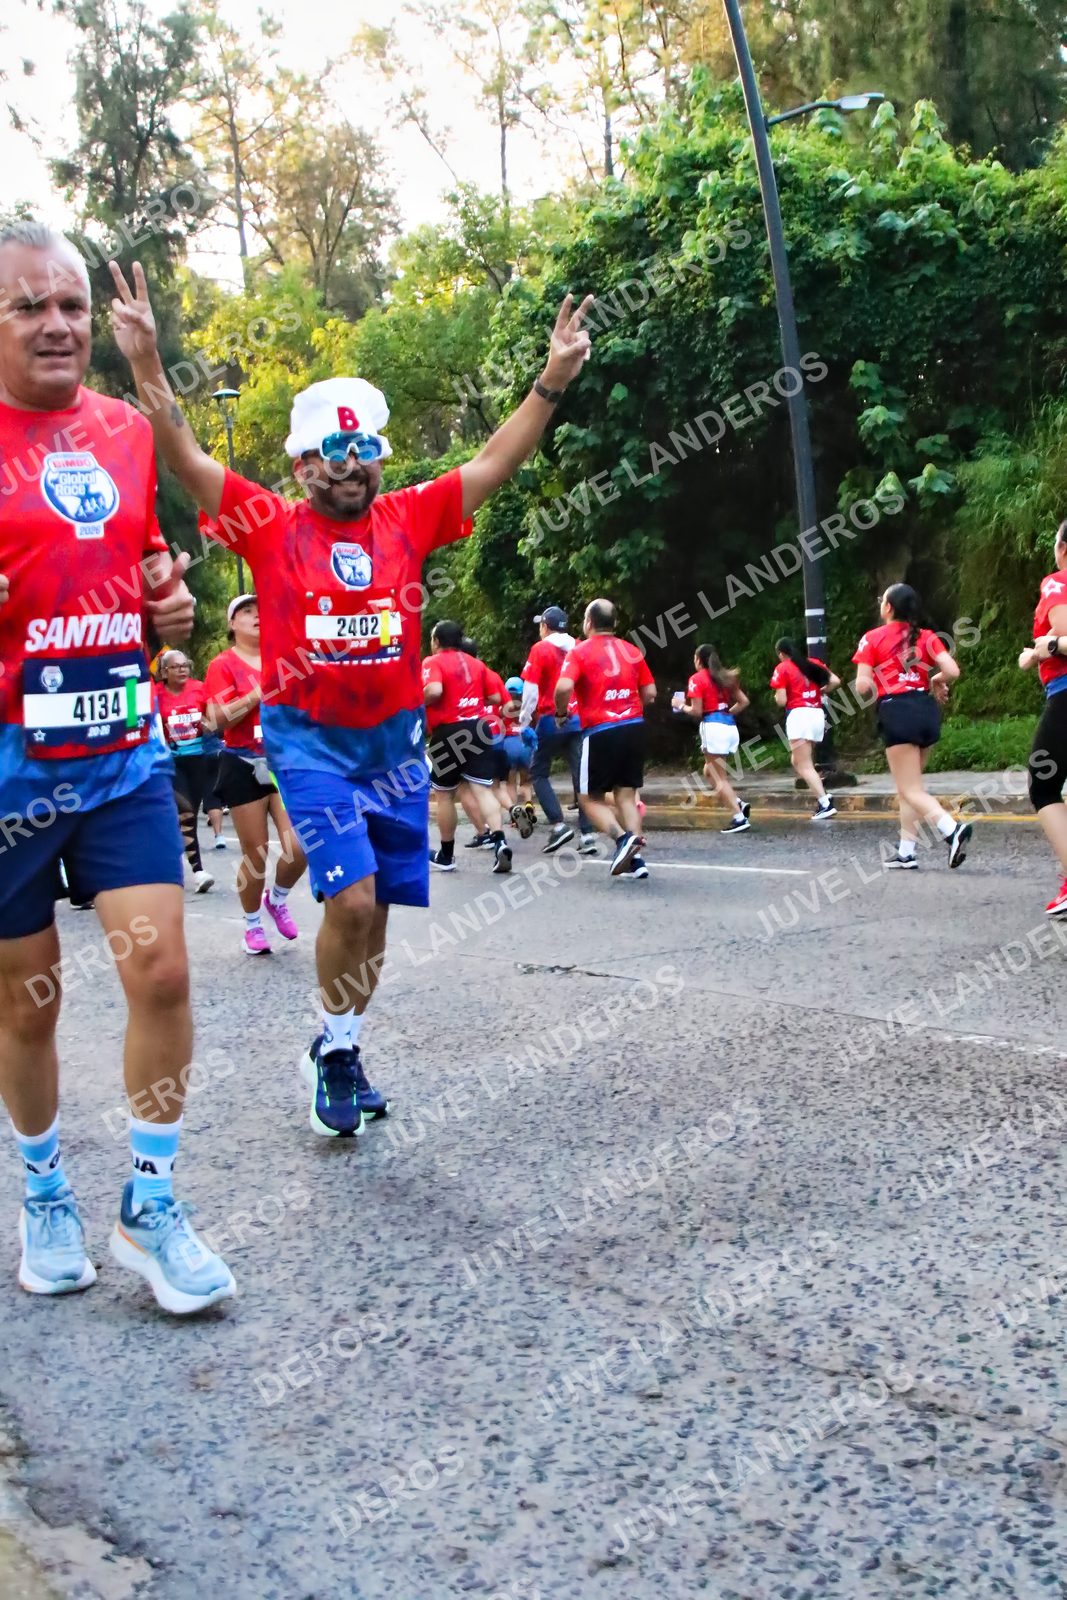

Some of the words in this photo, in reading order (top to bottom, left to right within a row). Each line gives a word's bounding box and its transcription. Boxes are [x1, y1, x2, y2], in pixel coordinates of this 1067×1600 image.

[337, 406, 360, 431] B
[25, 612, 142, 652] SANTIAGO
[337, 616, 379, 637] 2402
[73, 691, 121, 722] 4134
